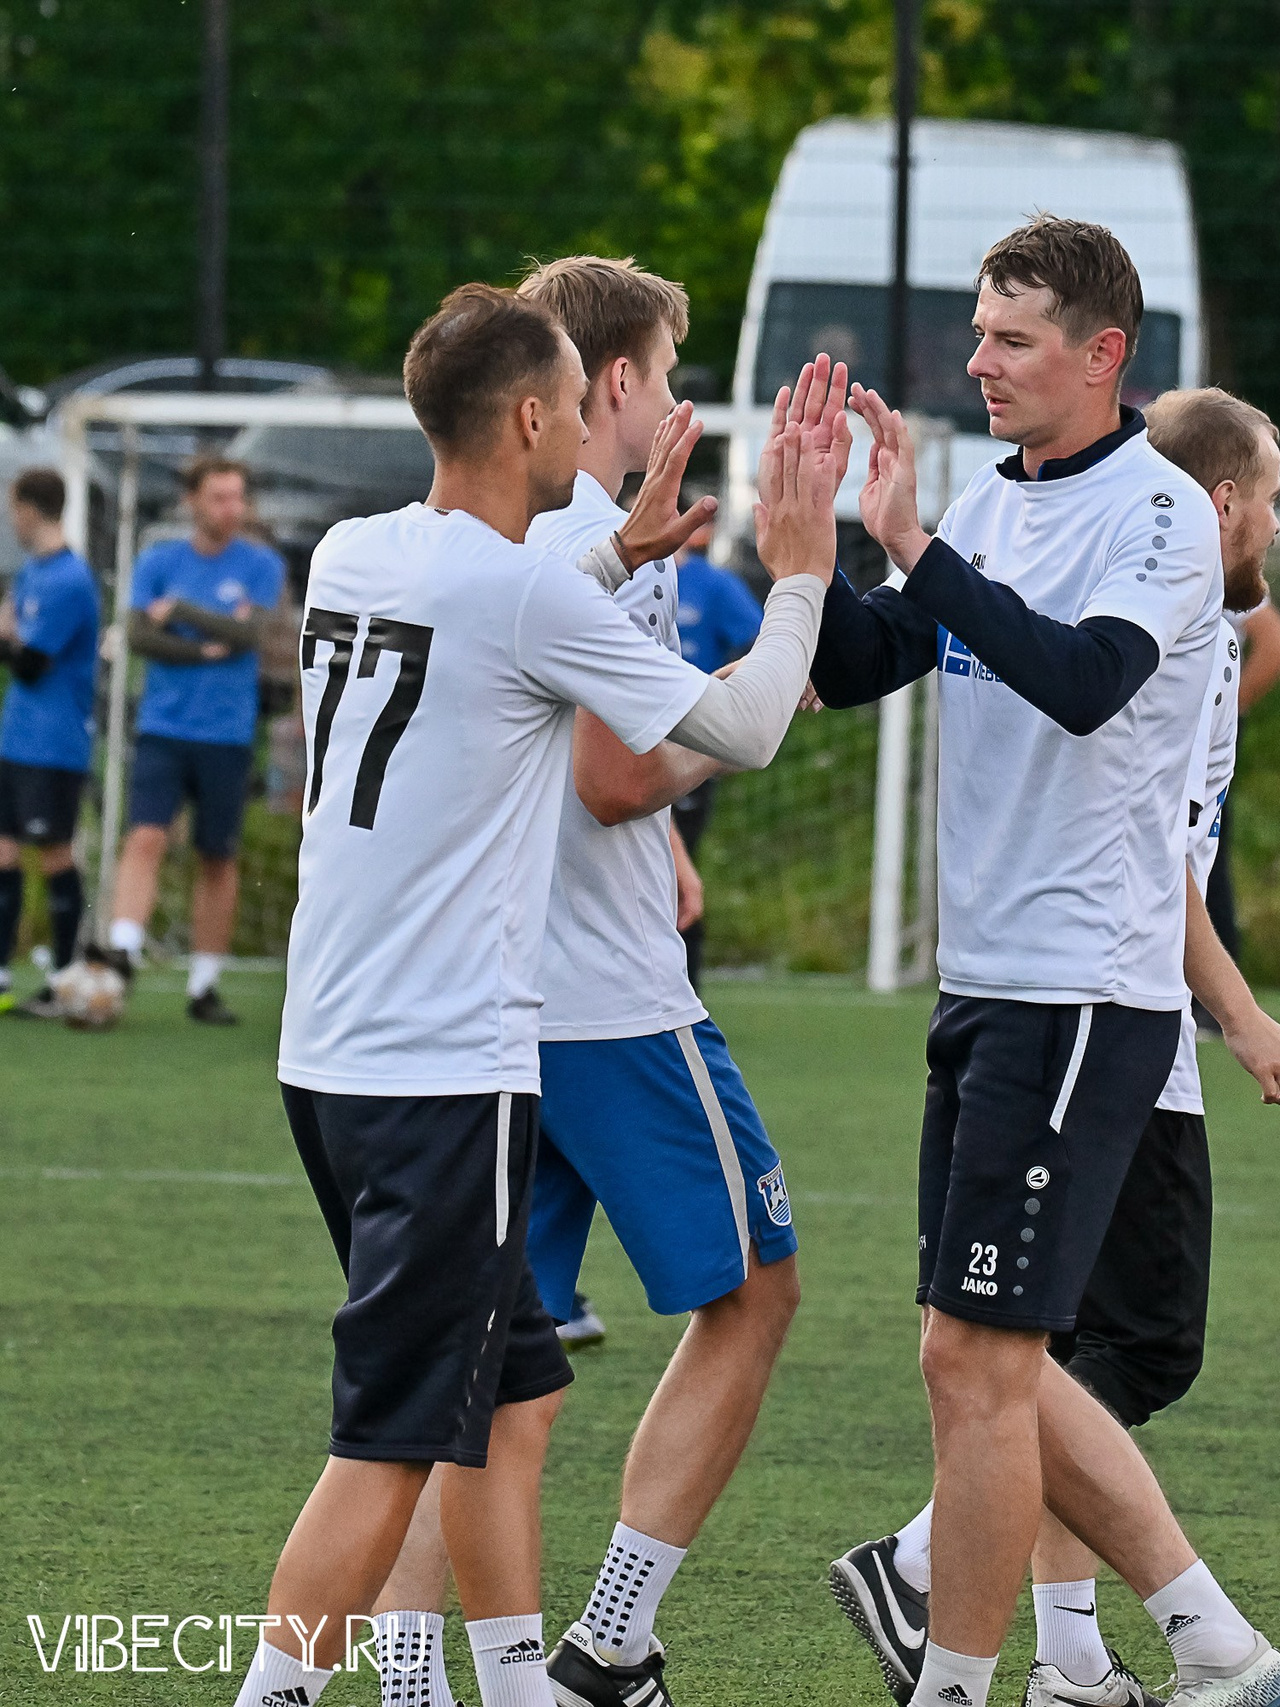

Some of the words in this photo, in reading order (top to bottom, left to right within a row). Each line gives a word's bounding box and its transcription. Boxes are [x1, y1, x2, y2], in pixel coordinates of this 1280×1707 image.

[302, 607, 434, 831] 77
[968, 1241, 999, 1276] 23
[961, 1276, 998, 1296] JAKO
[937, 1691, 973, 1706] adidas
